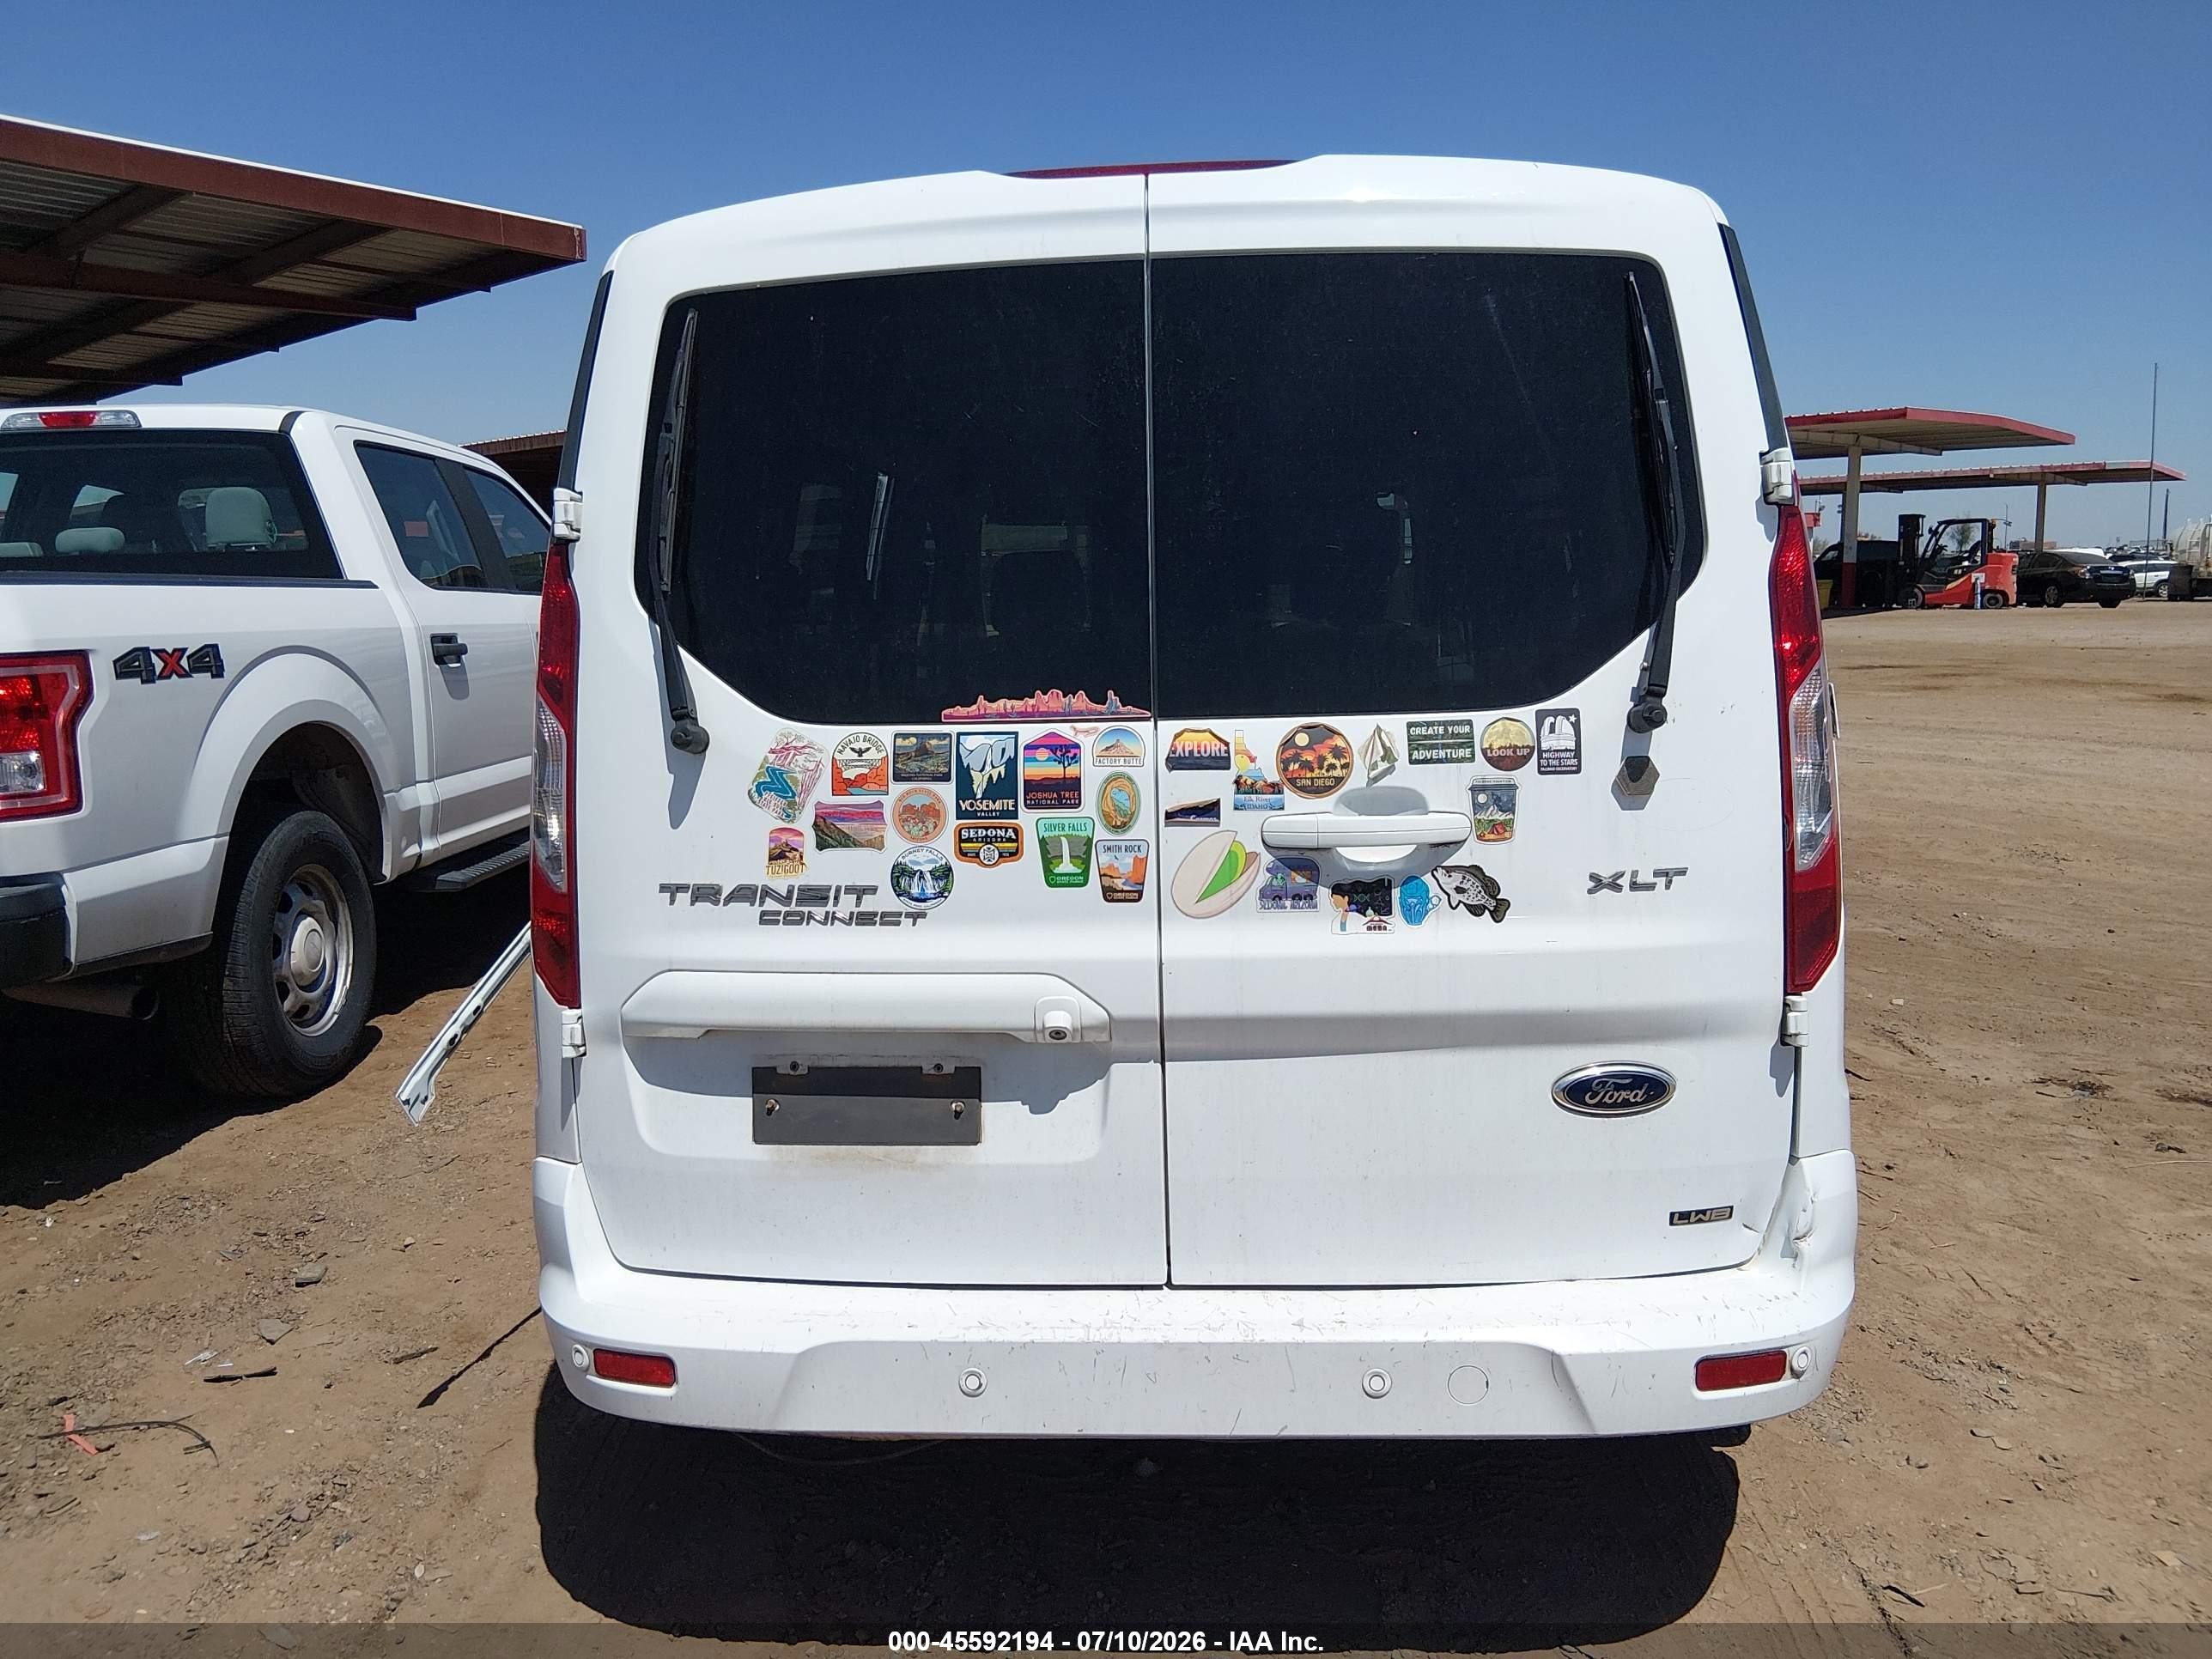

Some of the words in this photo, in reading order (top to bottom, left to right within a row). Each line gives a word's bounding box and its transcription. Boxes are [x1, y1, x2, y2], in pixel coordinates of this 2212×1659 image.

[1409, 726, 1445, 736] CREATE
[1447, 725, 1471, 734] YOUR
[836, 734, 860, 756] NAVAJO
[862, 734, 885, 754] BRIDGE
[1169, 741, 1229, 757] EXPLORE
[1412, 748, 1473, 760] ADVENTURE
[1296, 778, 1312, 787] SAN
[1313, 778, 1335, 787] DIEGO
[958, 799, 1016, 811] YOSEMITE
[961, 828, 1017, 839] SEDONA
[1043, 823, 1066, 833] SILVER
[1068, 822, 1088, 832] FALLS
[901, 848, 925, 860] BURNEY
[925, 848, 944, 861] FALLS
[1103, 844, 1122, 854] SMITH
[1124, 844, 1142, 854] ROCK
[766, 864, 804, 874] TUZIGOOT
[1587, 867, 1689, 895] XLT
[659, 884, 878, 908] TRANSIT
[758, 910, 927, 927] CONNECT
[1584, 1078, 1649, 1104] Ford
[1672, 1207, 1732, 1224] LWB
